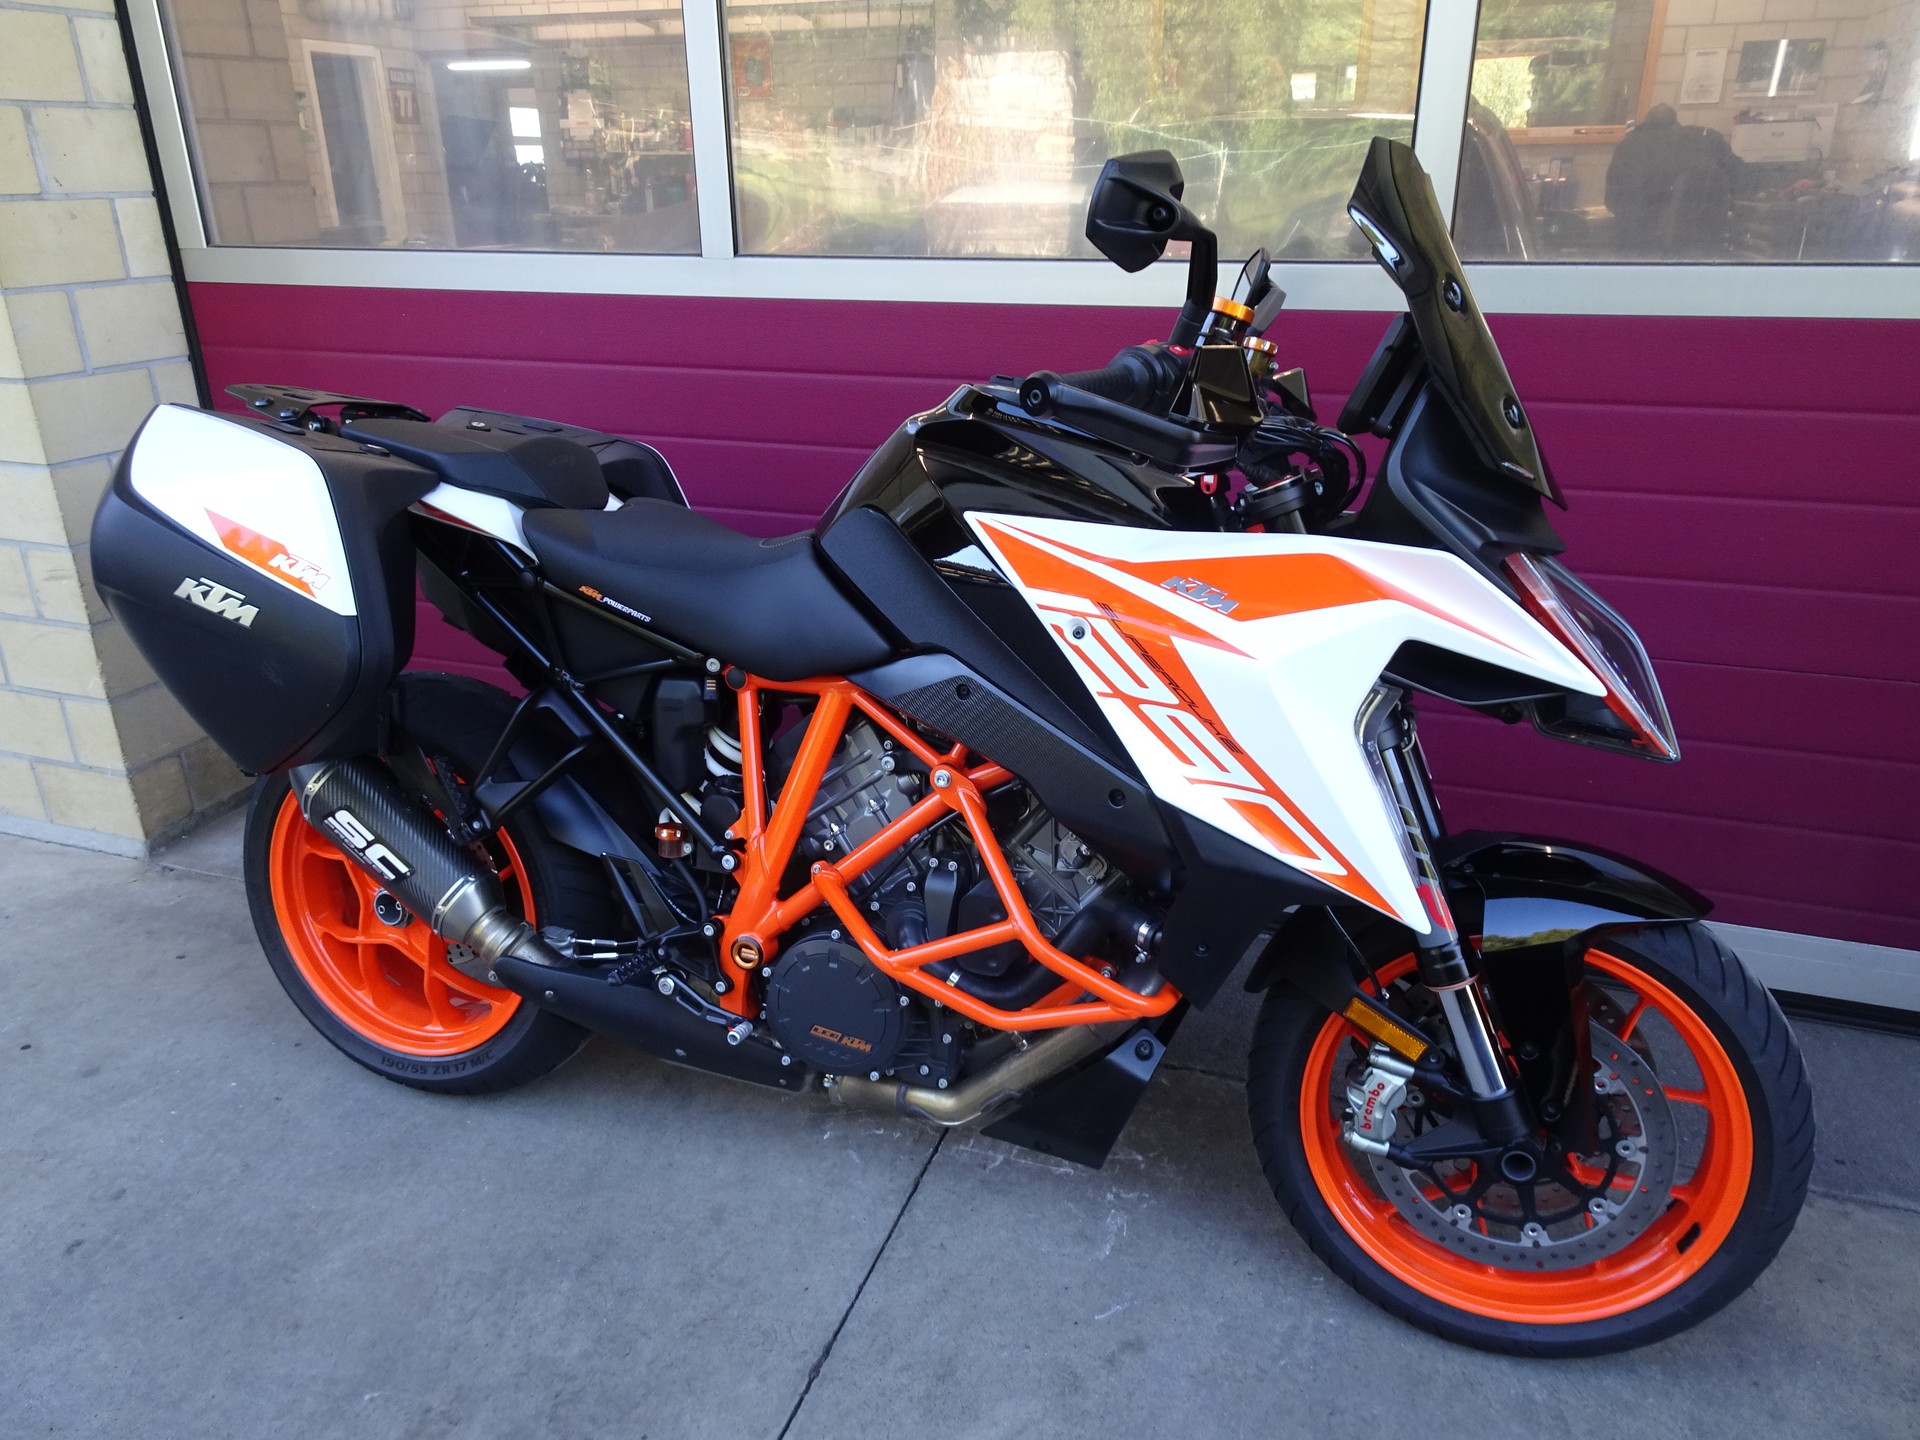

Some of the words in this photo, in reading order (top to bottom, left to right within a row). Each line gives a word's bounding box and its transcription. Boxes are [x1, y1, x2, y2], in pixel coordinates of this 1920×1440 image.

[267, 553, 331, 590] KTM
[173, 577, 260, 628] KTM
[1160, 576, 1240, 615] KTM
[326, 809, 410, 880] SC
[380, 1055, 428, 1075] 190/55
[432, 1064, 451, 1075] ZR
[455, 1061, 468, 1073] 17
[470, 1049, 495, 1069] M/C
[841, 1036, 872, 1052] KTM
[1360, 1082, 1385, 1131] brembo
